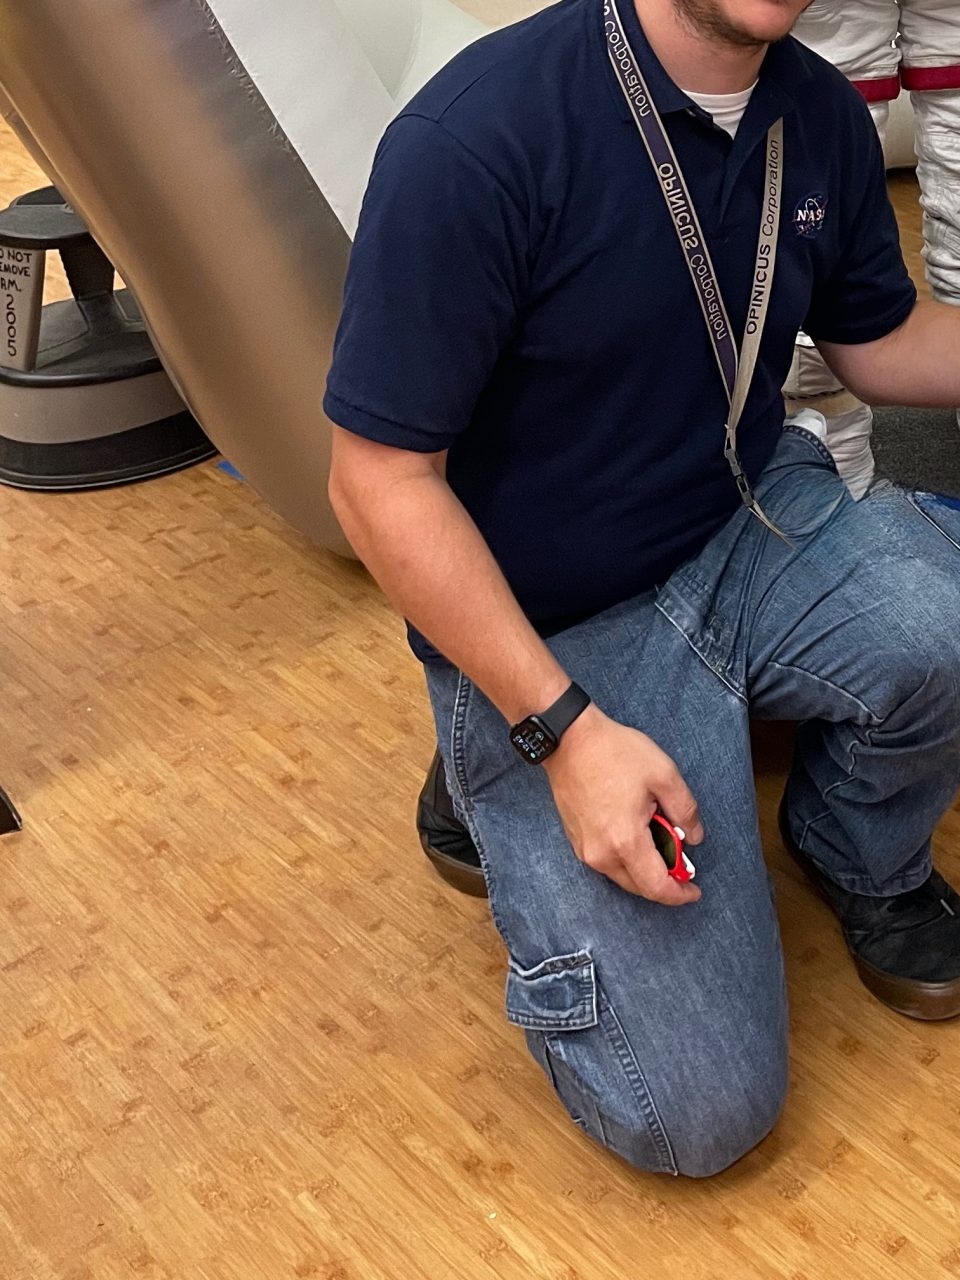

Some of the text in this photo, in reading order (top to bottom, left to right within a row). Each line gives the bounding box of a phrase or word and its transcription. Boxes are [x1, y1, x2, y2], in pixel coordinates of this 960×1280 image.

[8, 250, 32, 263] NOT
[746, 139, 779, 335] OPINICUS Corporation
[0, 262, 31, 277] MOVE
[6, 294, 17, 357] 2005
